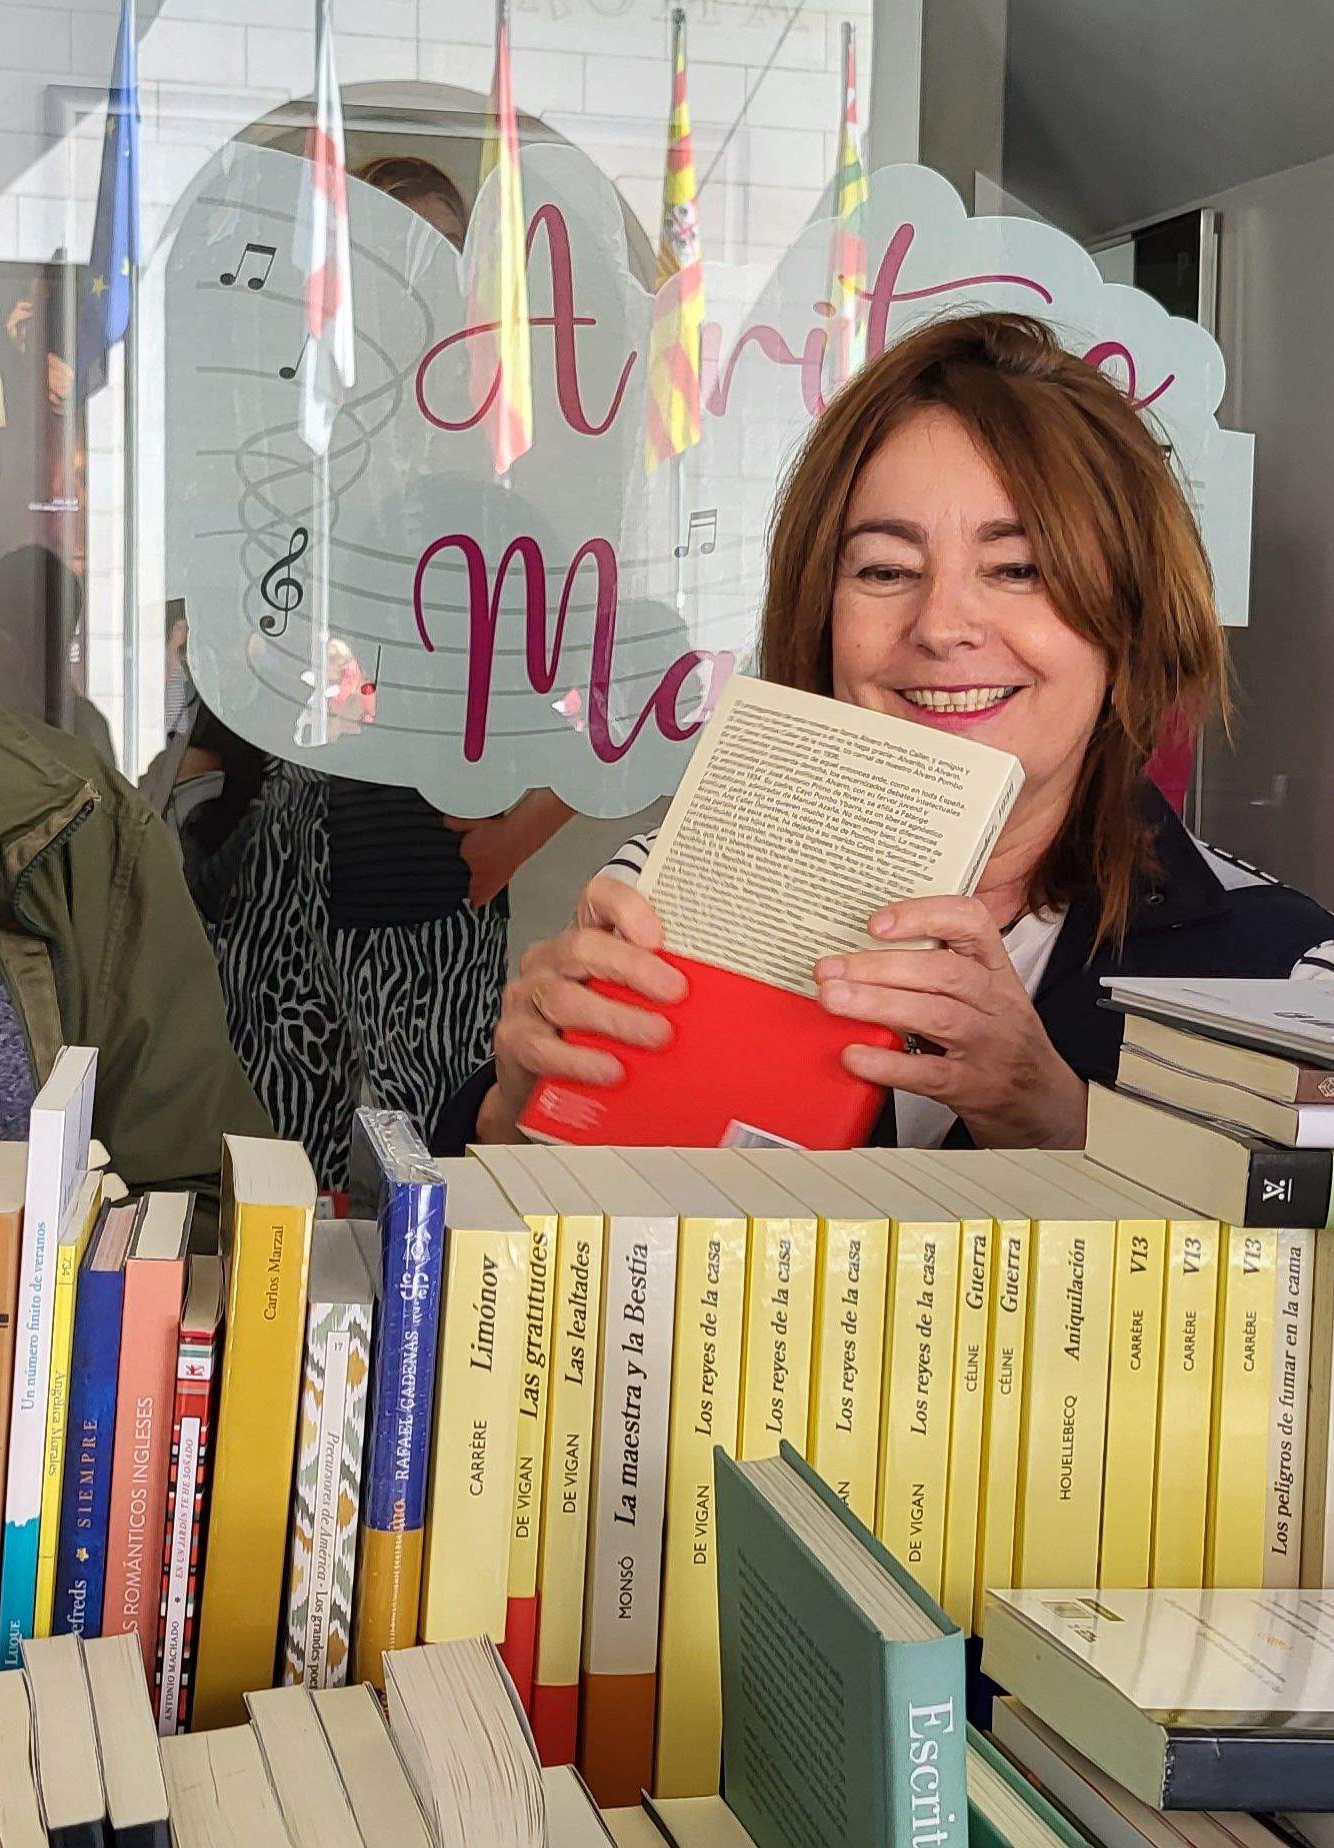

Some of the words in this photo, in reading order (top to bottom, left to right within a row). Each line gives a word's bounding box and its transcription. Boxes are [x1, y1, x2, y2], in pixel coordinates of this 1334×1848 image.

[623, 1243, 648, 1325] Bestia
[965, 1234, 988, 1310] Guerra
[999, 1237, 1022, 1314] Guerra
[1130, 1235, 1149, 1275] V13
[1183, 1237, 1203, 1277] V13
[25, 1335, 39, 1387] número
[35, 1221, 46, 1272] veranos
[263, 1271, 282, 1322] Carlos
[469, 1252, 499, 1374] Limónov
[525, 1232, 548, 1369] gratitudes
[566, 1240, 590, 1341] lealtades
[1064, 1237, 1087, 1362] Aniquilación
[334, 1342, 343, 1351] 17
[565, 1345, 586, 1387] Las
[621, 1333, 644, 1355] la
[966, 1344, 980, 1393] CÉLINE
[1129, 1309, 1144, 1372] CARRÈRE
[1183, 1310, 1197, 1372] CARRÈRE
[519, 1372, 540, 1421] Las
[1000, 1347, 1014, 1395] CÉLINE
[131, 1396, 154, 1485] INGLESES
[468, 1419, 488, 1496] CARRÈRE
[564, 1433, 580, 1488] VIGAN
[621, 1384, 643, 1489] maestra
[1059, 1394, 1078, 1501] HOUELLEBECQ
[77, 1417, 99, 1529] SIEMPRE
[518, 1456, 533, 1513] VIGAN
[563, 1491, 577, 1514] DE
[515, 1516, 530, 1539] DE
[614, 1495, 637, 1527] La
[695, 1485, 710, 1540] VIGAN
[912, 1483, 925, 1538] VIGAN
[121, 1488, 149, 1618] ROMÁNTICOS
[694, 1543, 707, 1565] DE
[617, 1555, 634, 1620] MONSÓ
